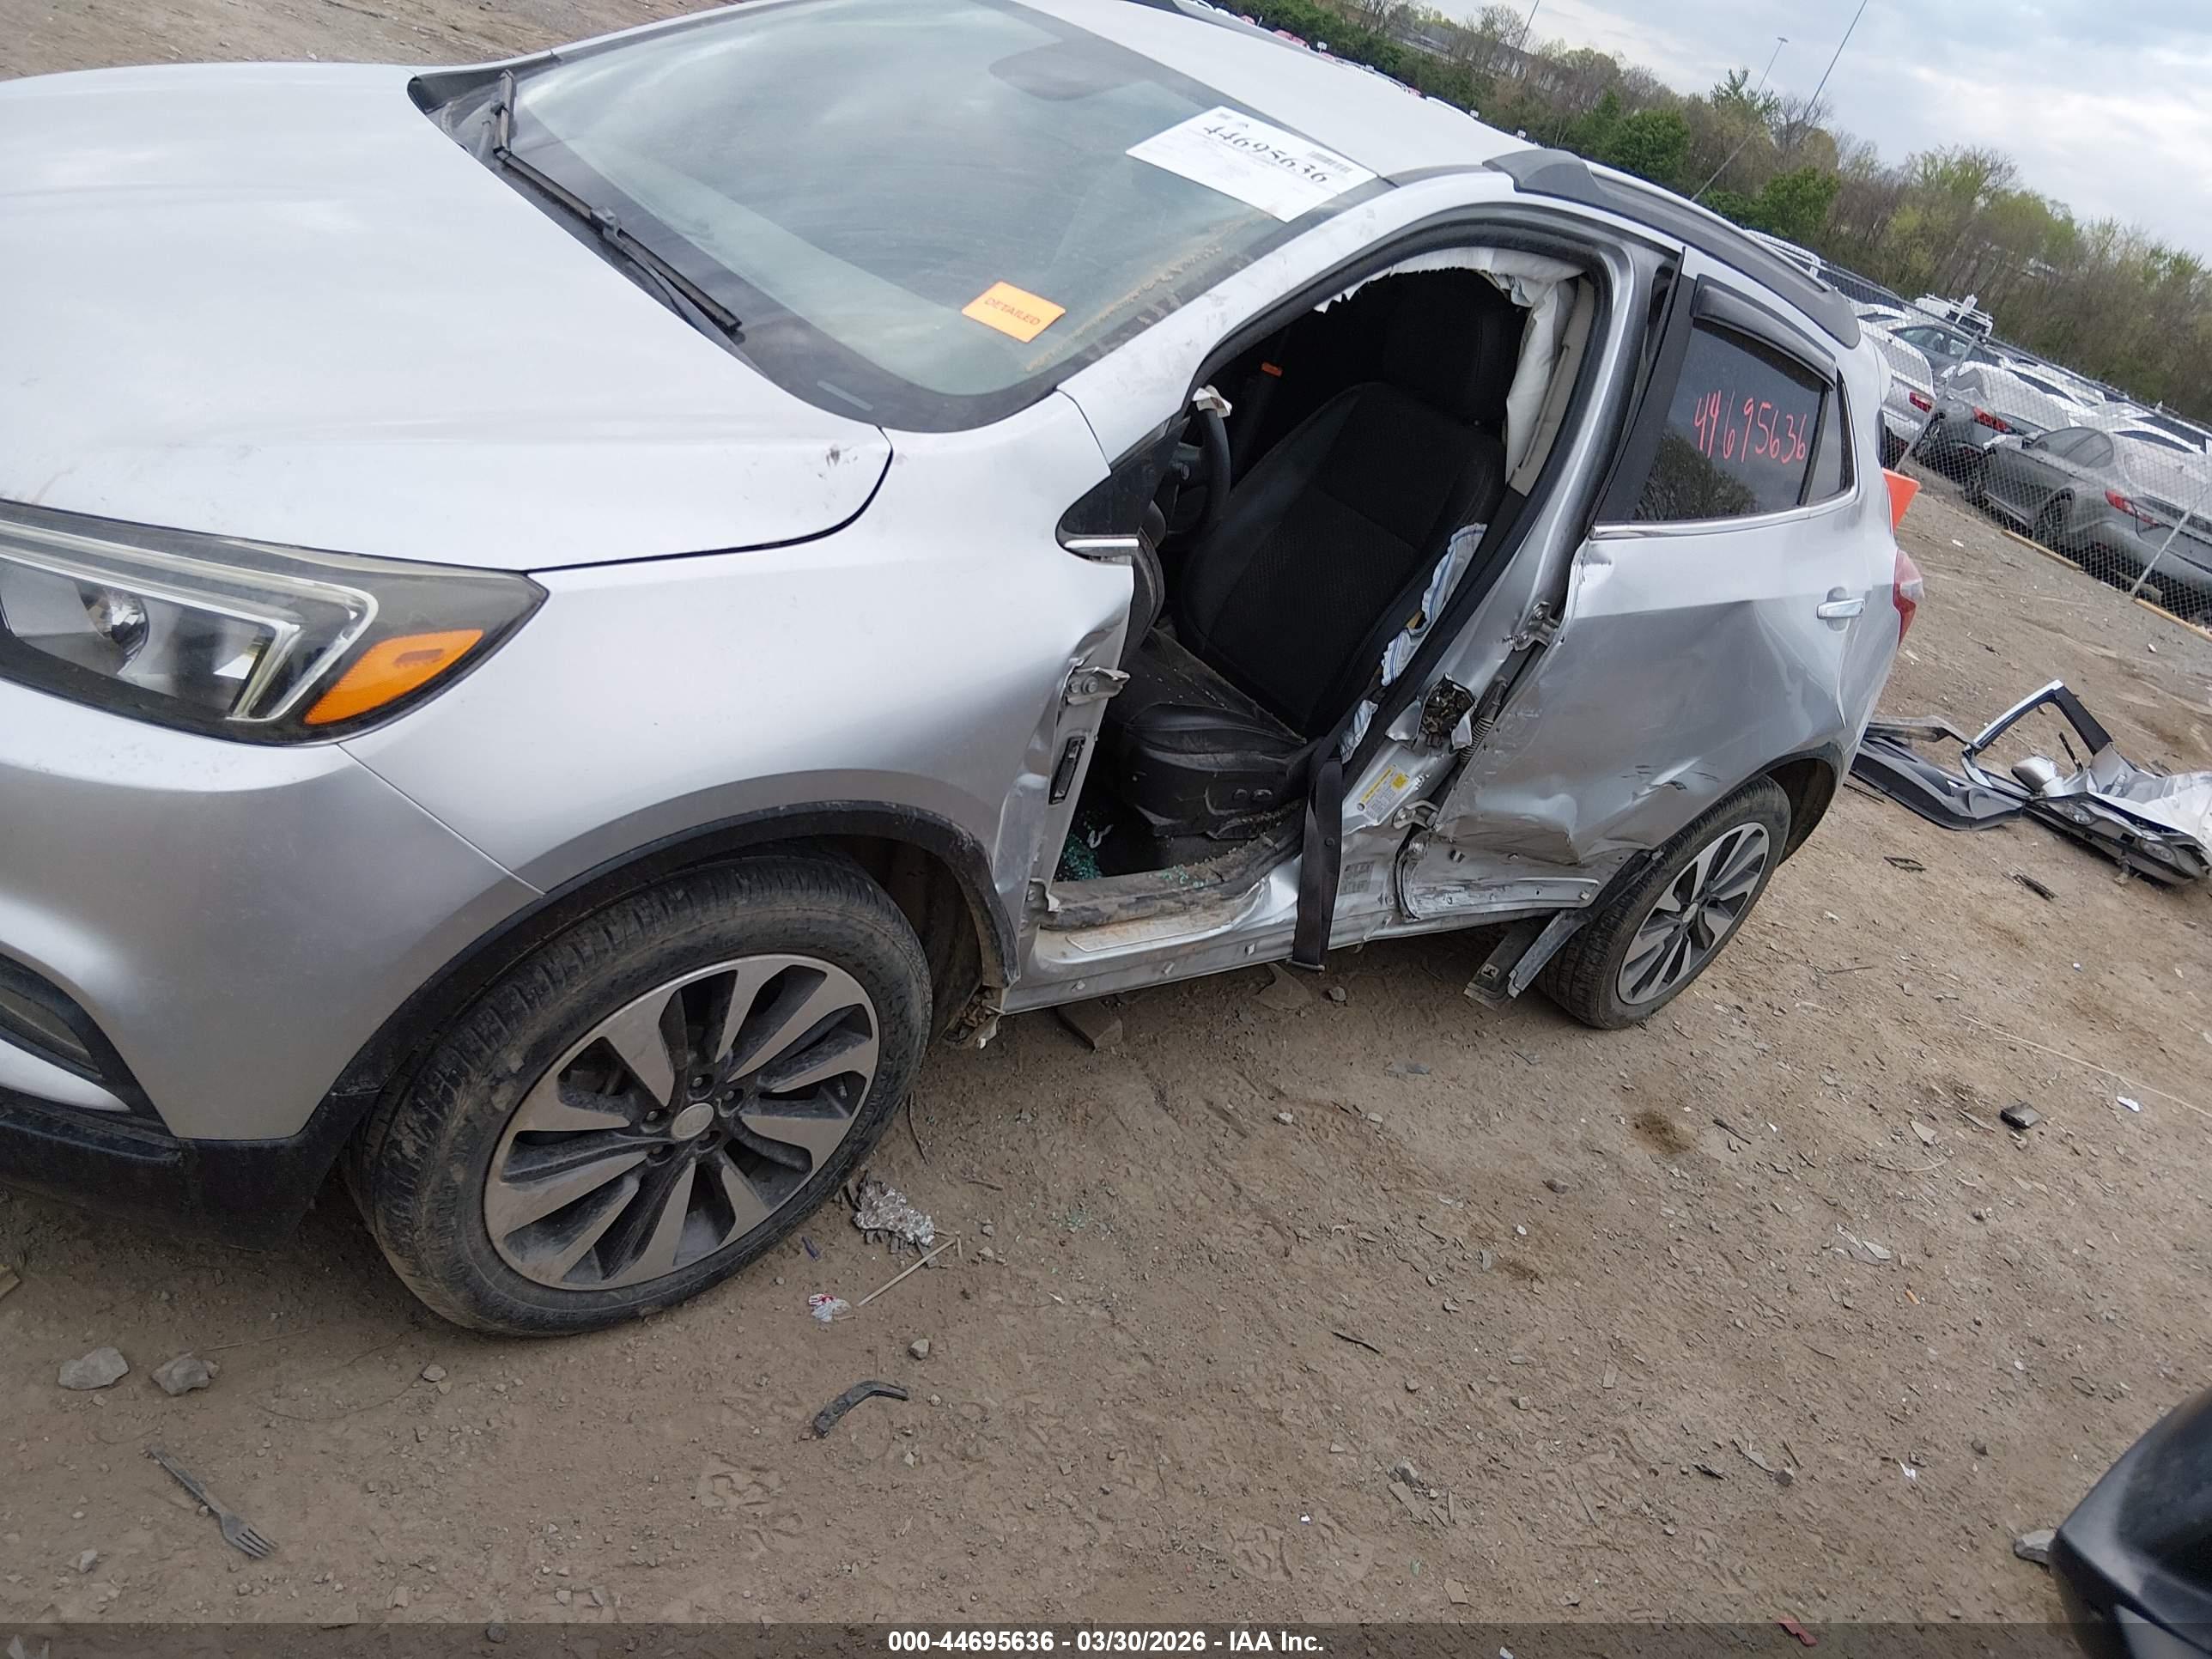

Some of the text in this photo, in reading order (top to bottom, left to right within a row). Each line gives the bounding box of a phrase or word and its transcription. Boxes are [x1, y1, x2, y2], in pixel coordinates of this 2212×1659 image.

[1202, 125, 1329, 184] 44695636
[984, 297, 1042, 326] DETAILED
[1693, 389, 1808, 465] 44695636
